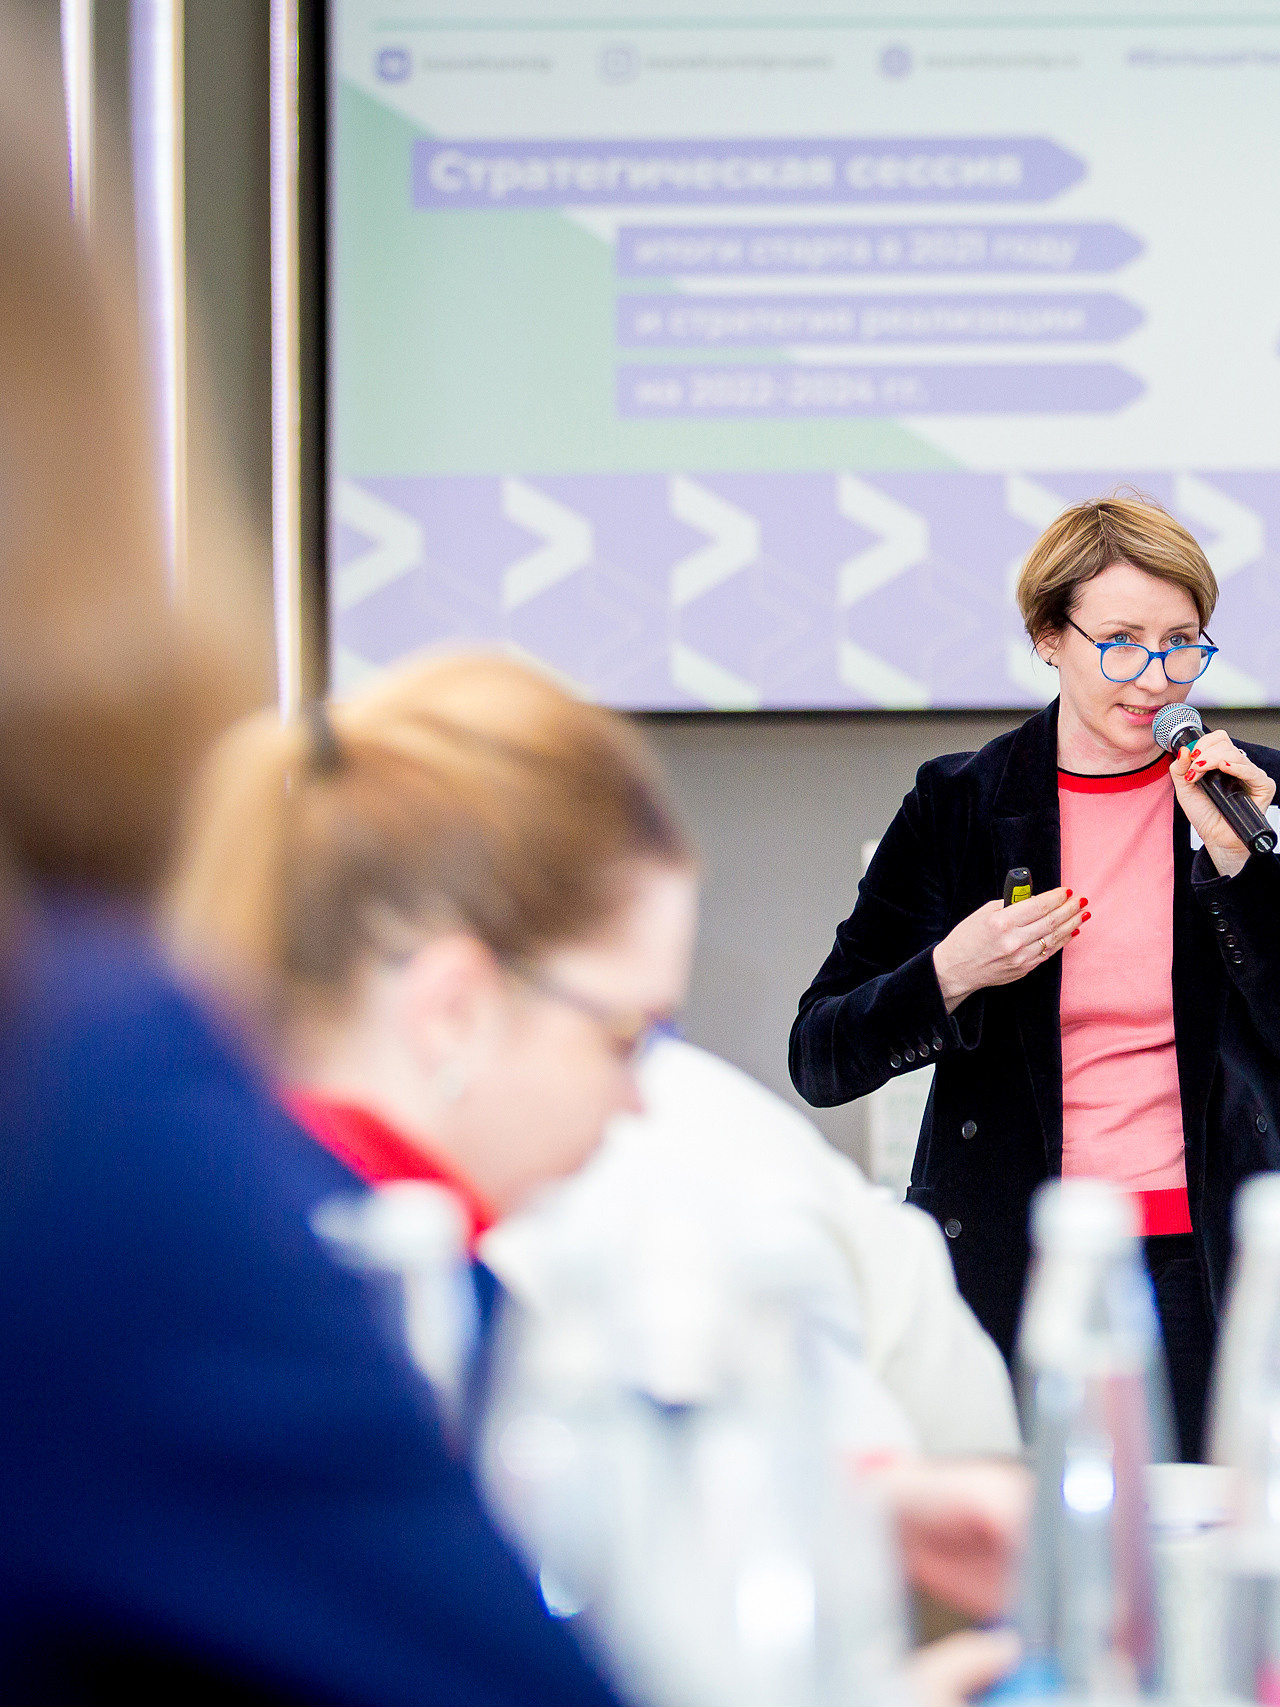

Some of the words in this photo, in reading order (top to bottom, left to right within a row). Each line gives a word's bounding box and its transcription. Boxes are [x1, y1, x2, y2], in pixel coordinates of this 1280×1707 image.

[429, 151, 833, 197] Стратегическая
[845, 154, 1023, 189] сессия
[634, 237, 742, 264] итоги
[749, 237, 871, 270] старта
[878, 239, 902, 262] в
[910, 232, 985, 261] 2021
[993, 236, 1080, 270] году
[634, 310, 660, 333] и
[670, 309, 853, 339] стратегия
[861, 309, 1086, 339] реализации
[634, 380, 682, 406] на
[690, 375, 875, 406] 2022-2024
